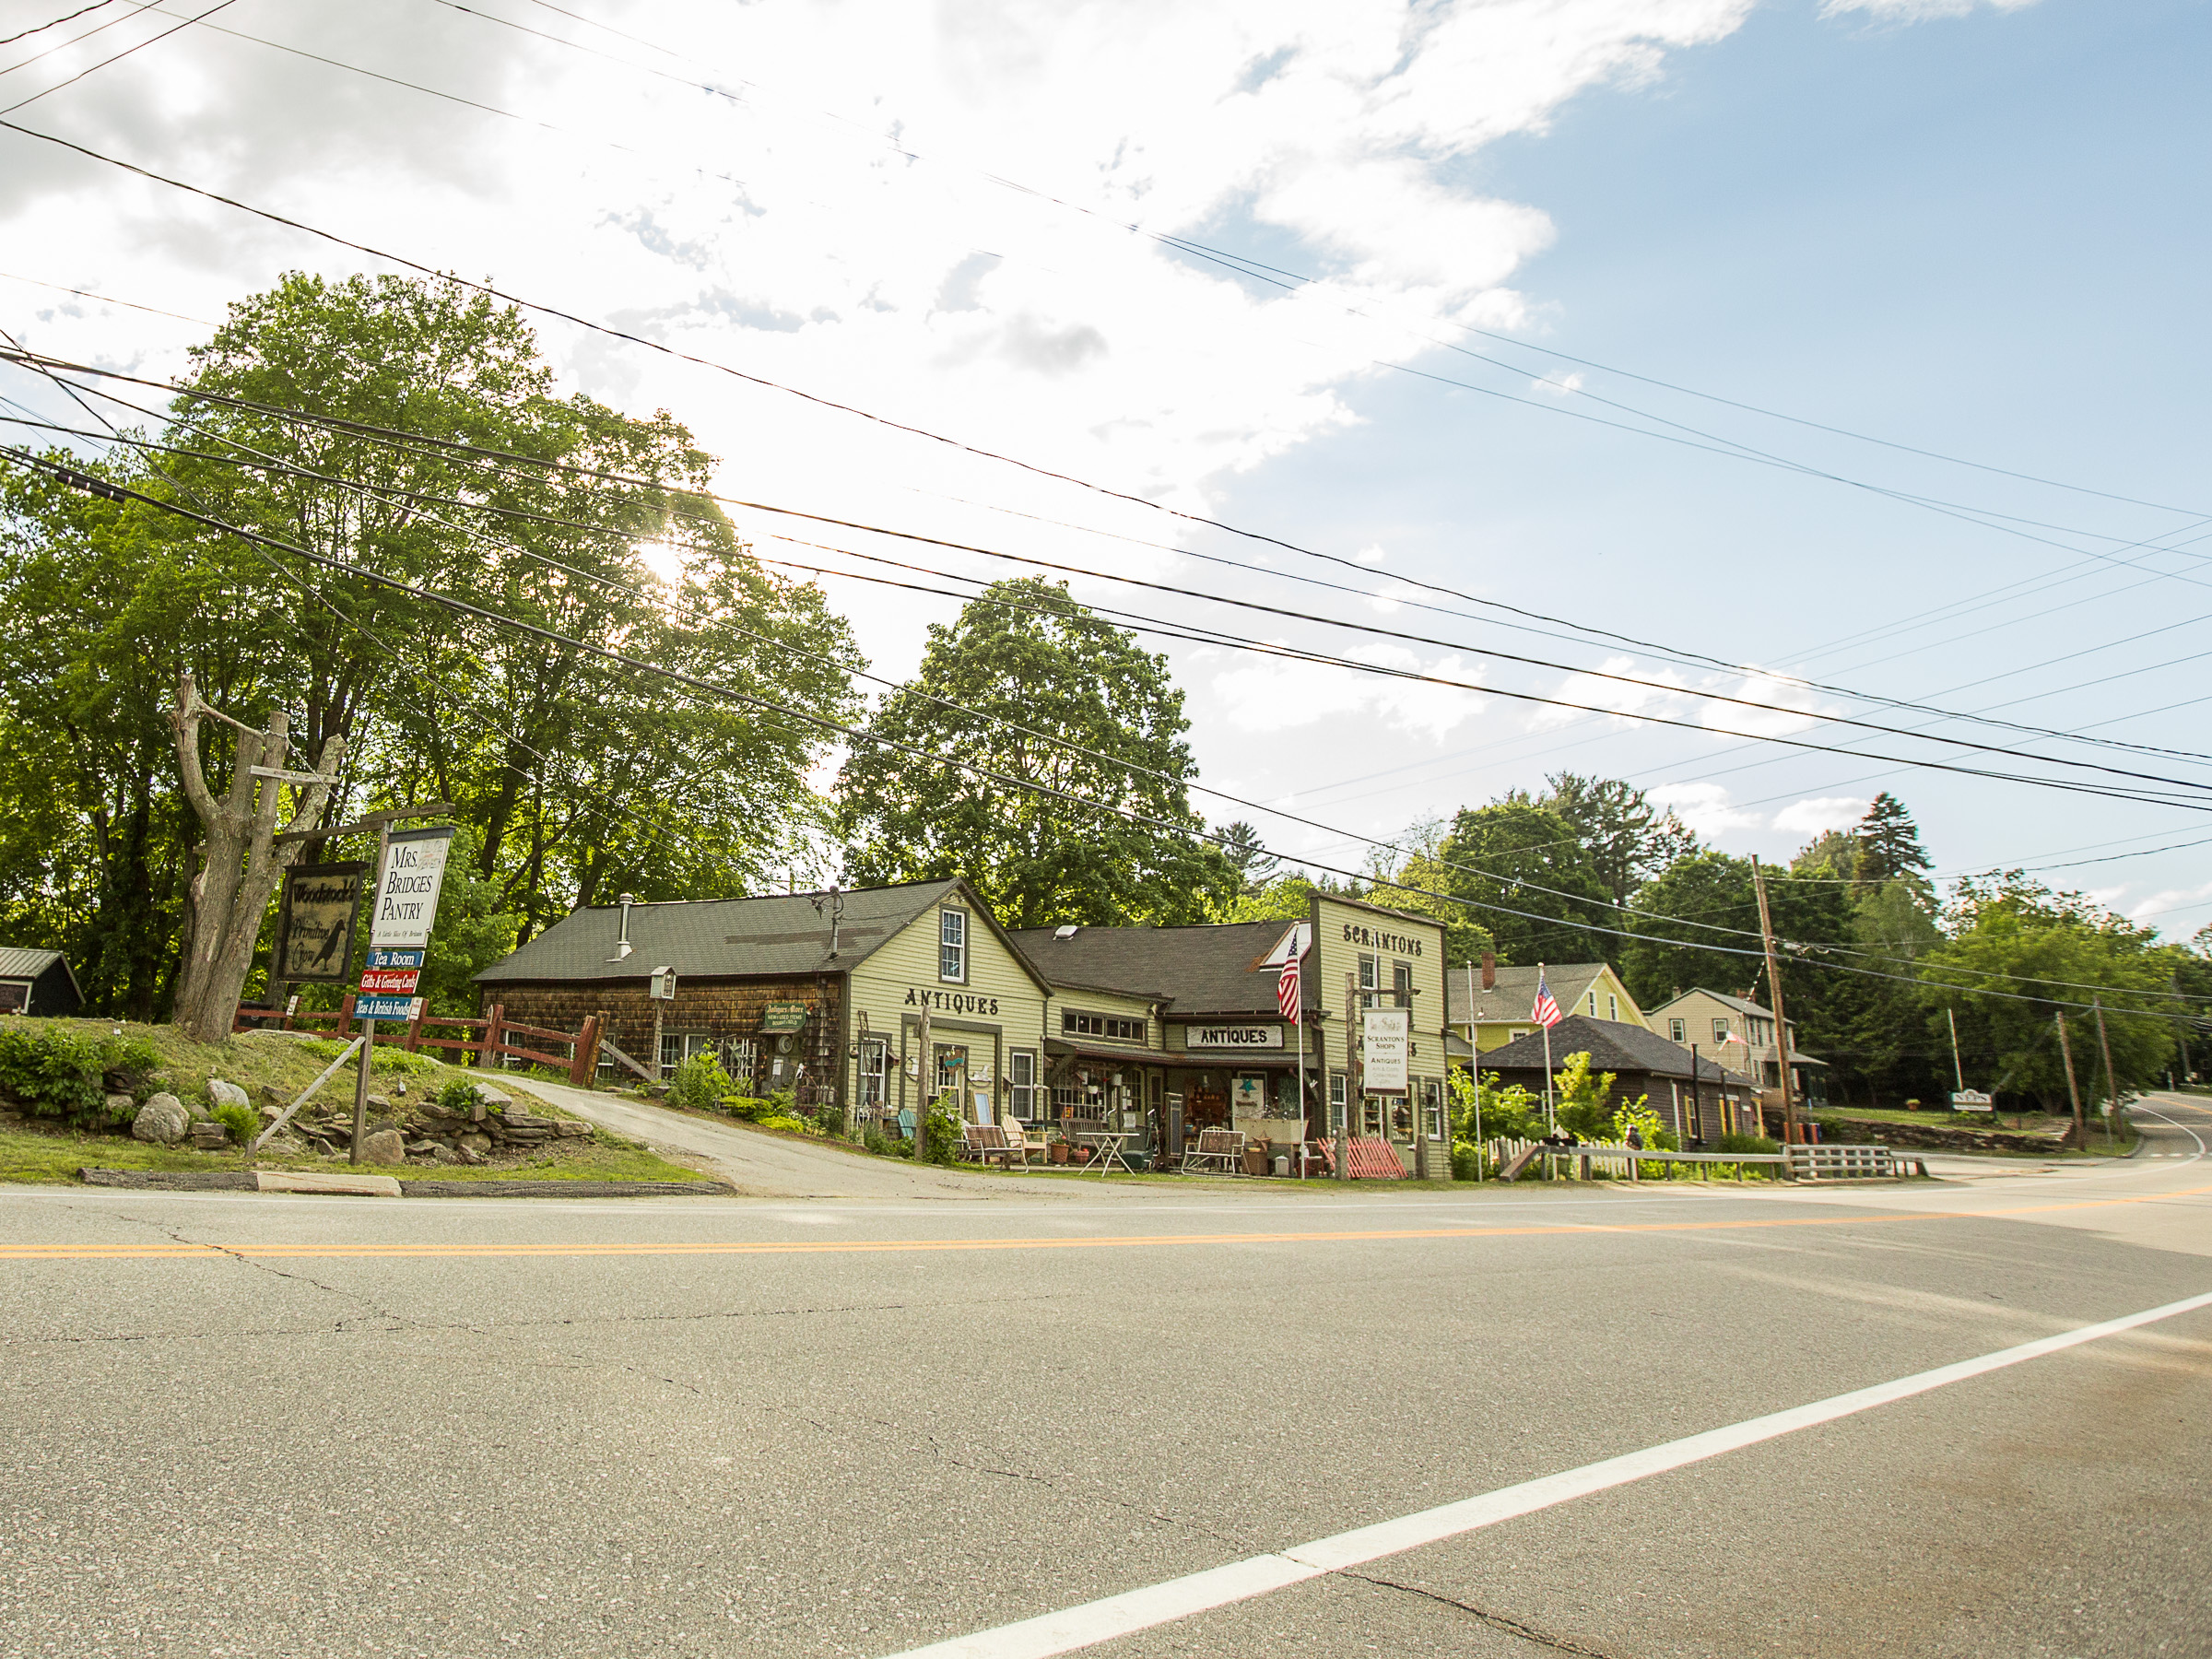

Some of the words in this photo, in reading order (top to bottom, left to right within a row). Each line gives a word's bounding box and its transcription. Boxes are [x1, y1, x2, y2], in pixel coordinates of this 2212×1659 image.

[391, 846, 418, 869] MRS.
[386, 871, 433, 895] BRIDGES
[381, 897, 424, 921] PANTRY
[1343, 924, 1422, 957] SCRANTONS
[292, 942, 315, 971] Crow
[374, 952, 388, 965] Tea
[390, 952, 415, 966] Room
[361, 974, 375, 988] Gifts
[375, 975, 382, 988] &
[381, 975, 402, 992] Greeting
[402, 974, 417, 988] Cards
[357, 1000, 369, 1014] Teas
[369, 1001, 375, 1014] &
[374, 1001, 393, 1015] British
[392, 1002, 411, 1016] Foods
[905, 988, 998, 1016] ANTIQUES
[587, 1016, 606, 1084] WELCOME
[1367, 1034, 1405, 1042] SCRANTON'S
